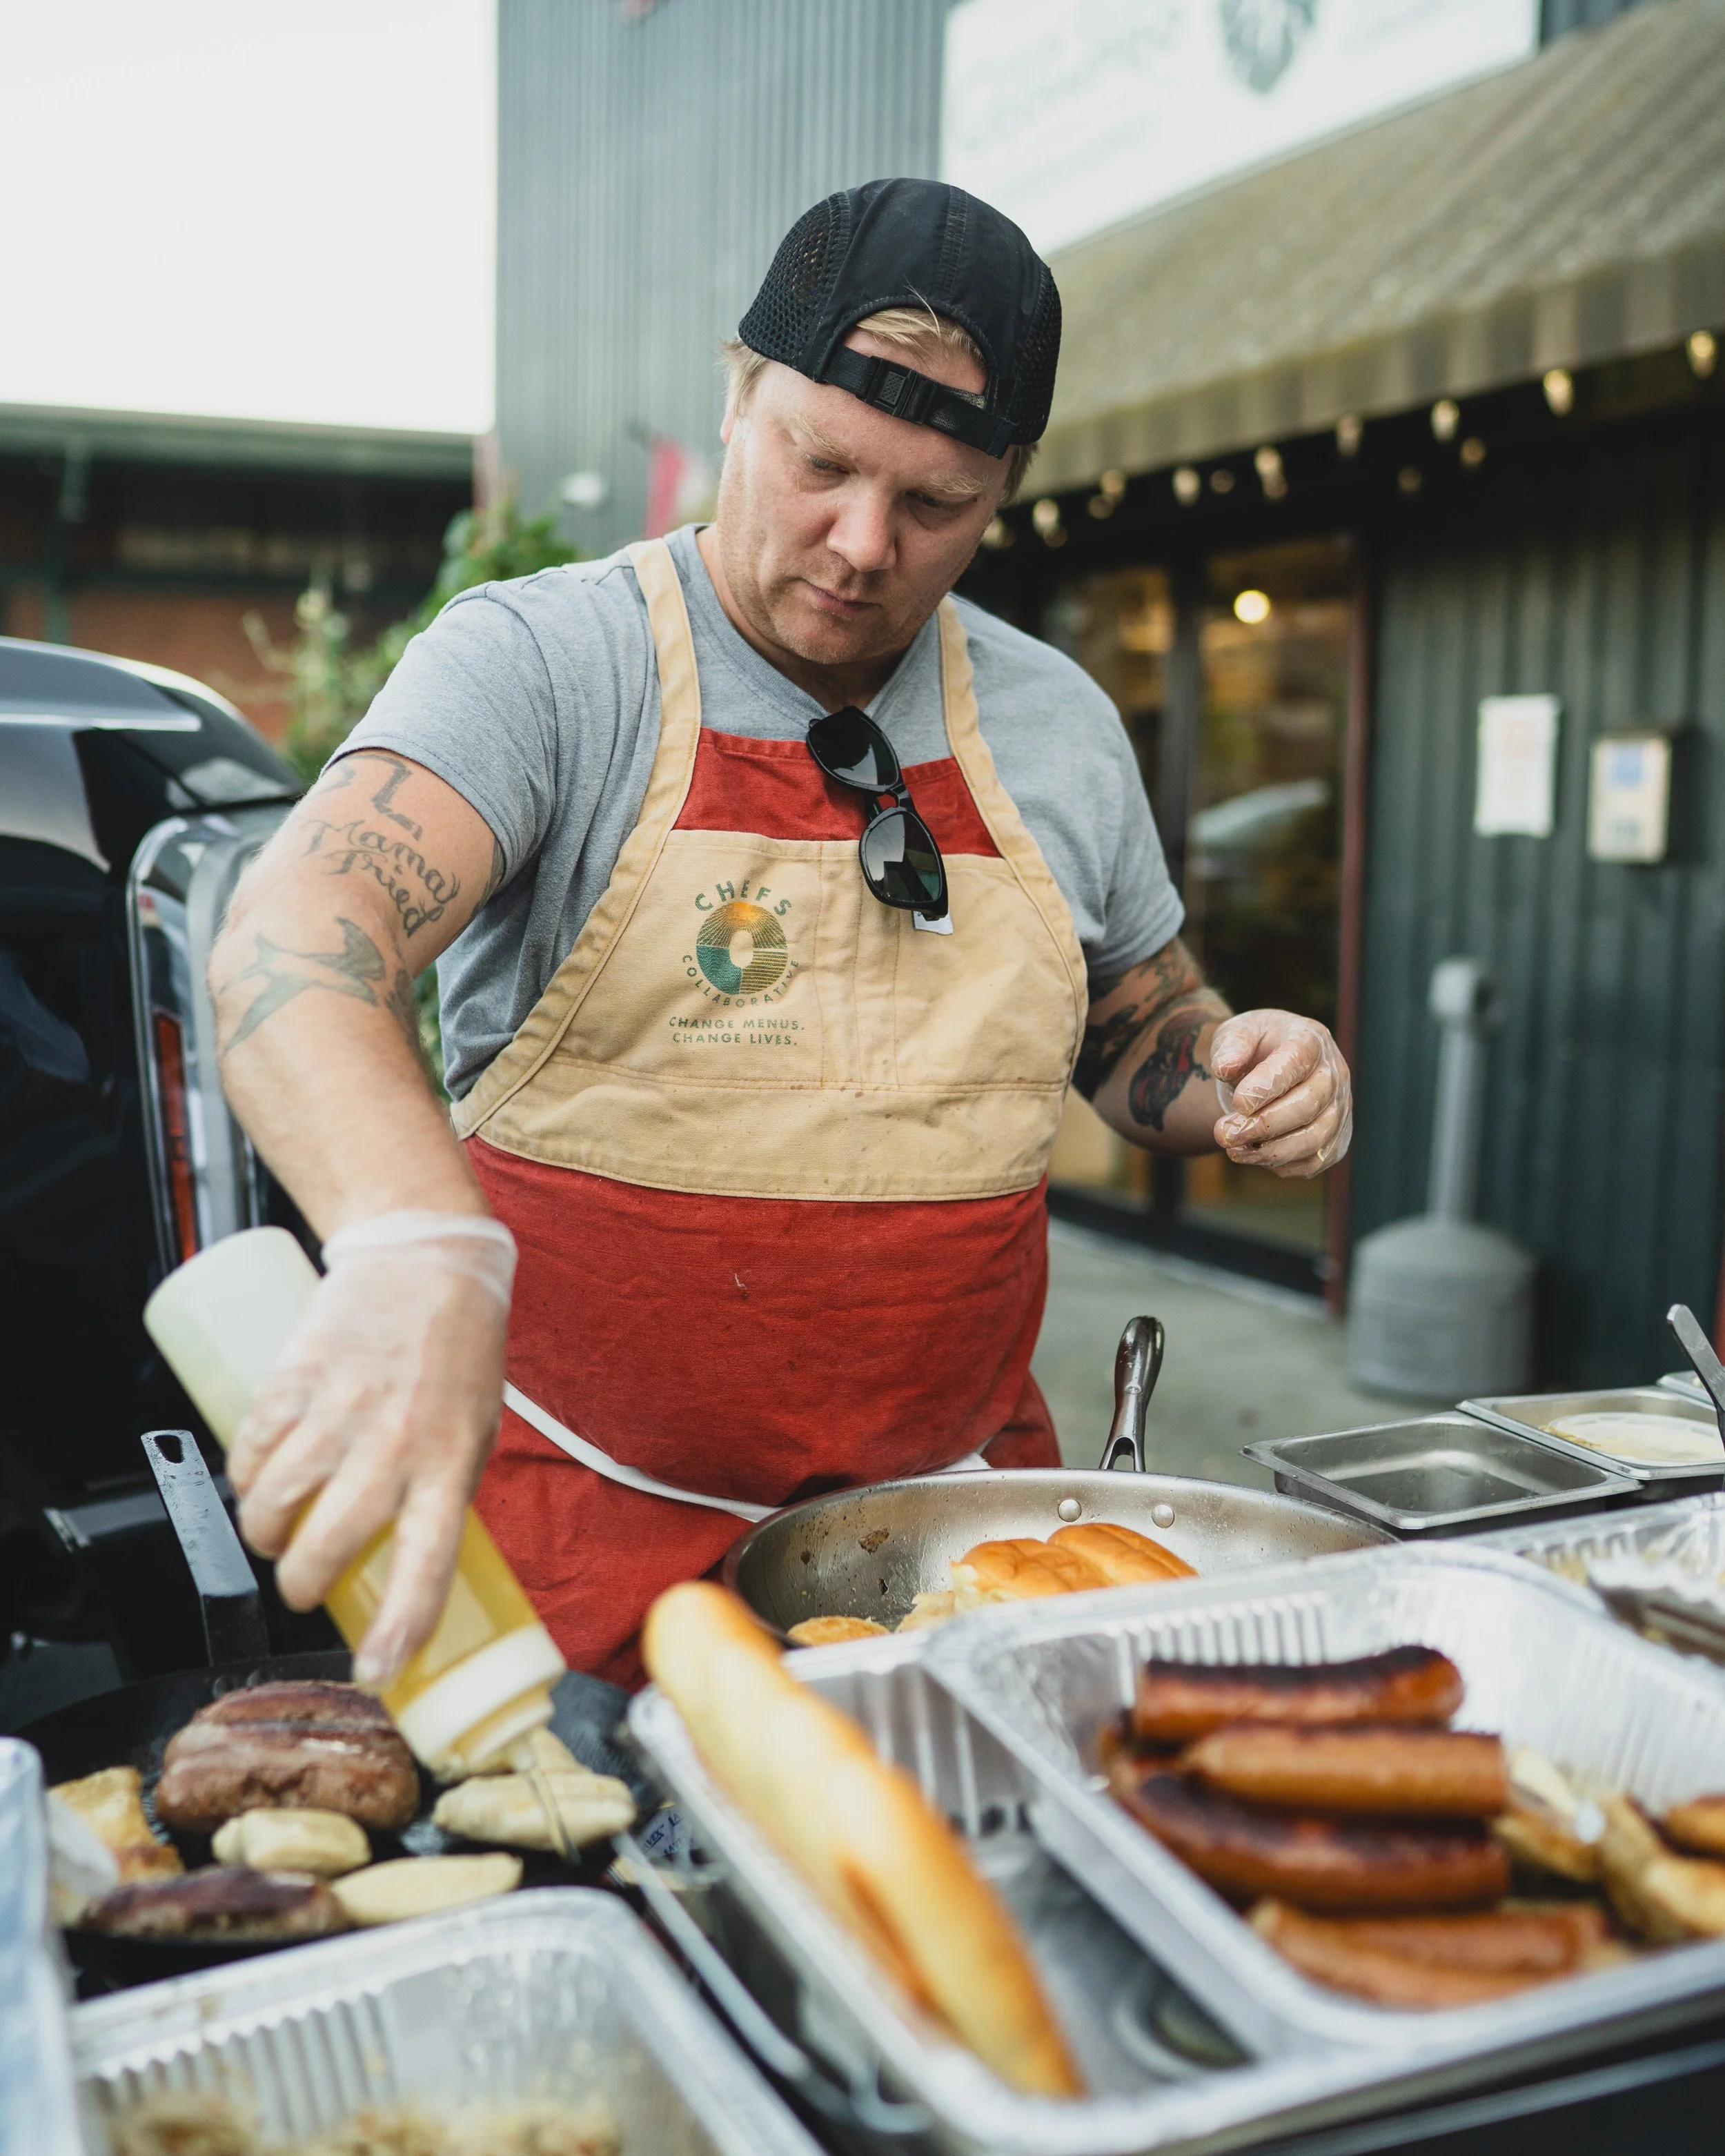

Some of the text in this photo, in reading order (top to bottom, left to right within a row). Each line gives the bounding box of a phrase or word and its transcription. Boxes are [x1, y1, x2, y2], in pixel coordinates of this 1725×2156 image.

[302, 820, 460, 904] Mama
[322, 850, 444, 938] Tried
[695, 879, 792, 916] CHEFS
[682, 954, 799, 1008] COLLABORATIVE
[669, 1016, 805, 1031] CHANGE MENUS.
[672, 1033, 798, 1046] CHANGE LIVES.
